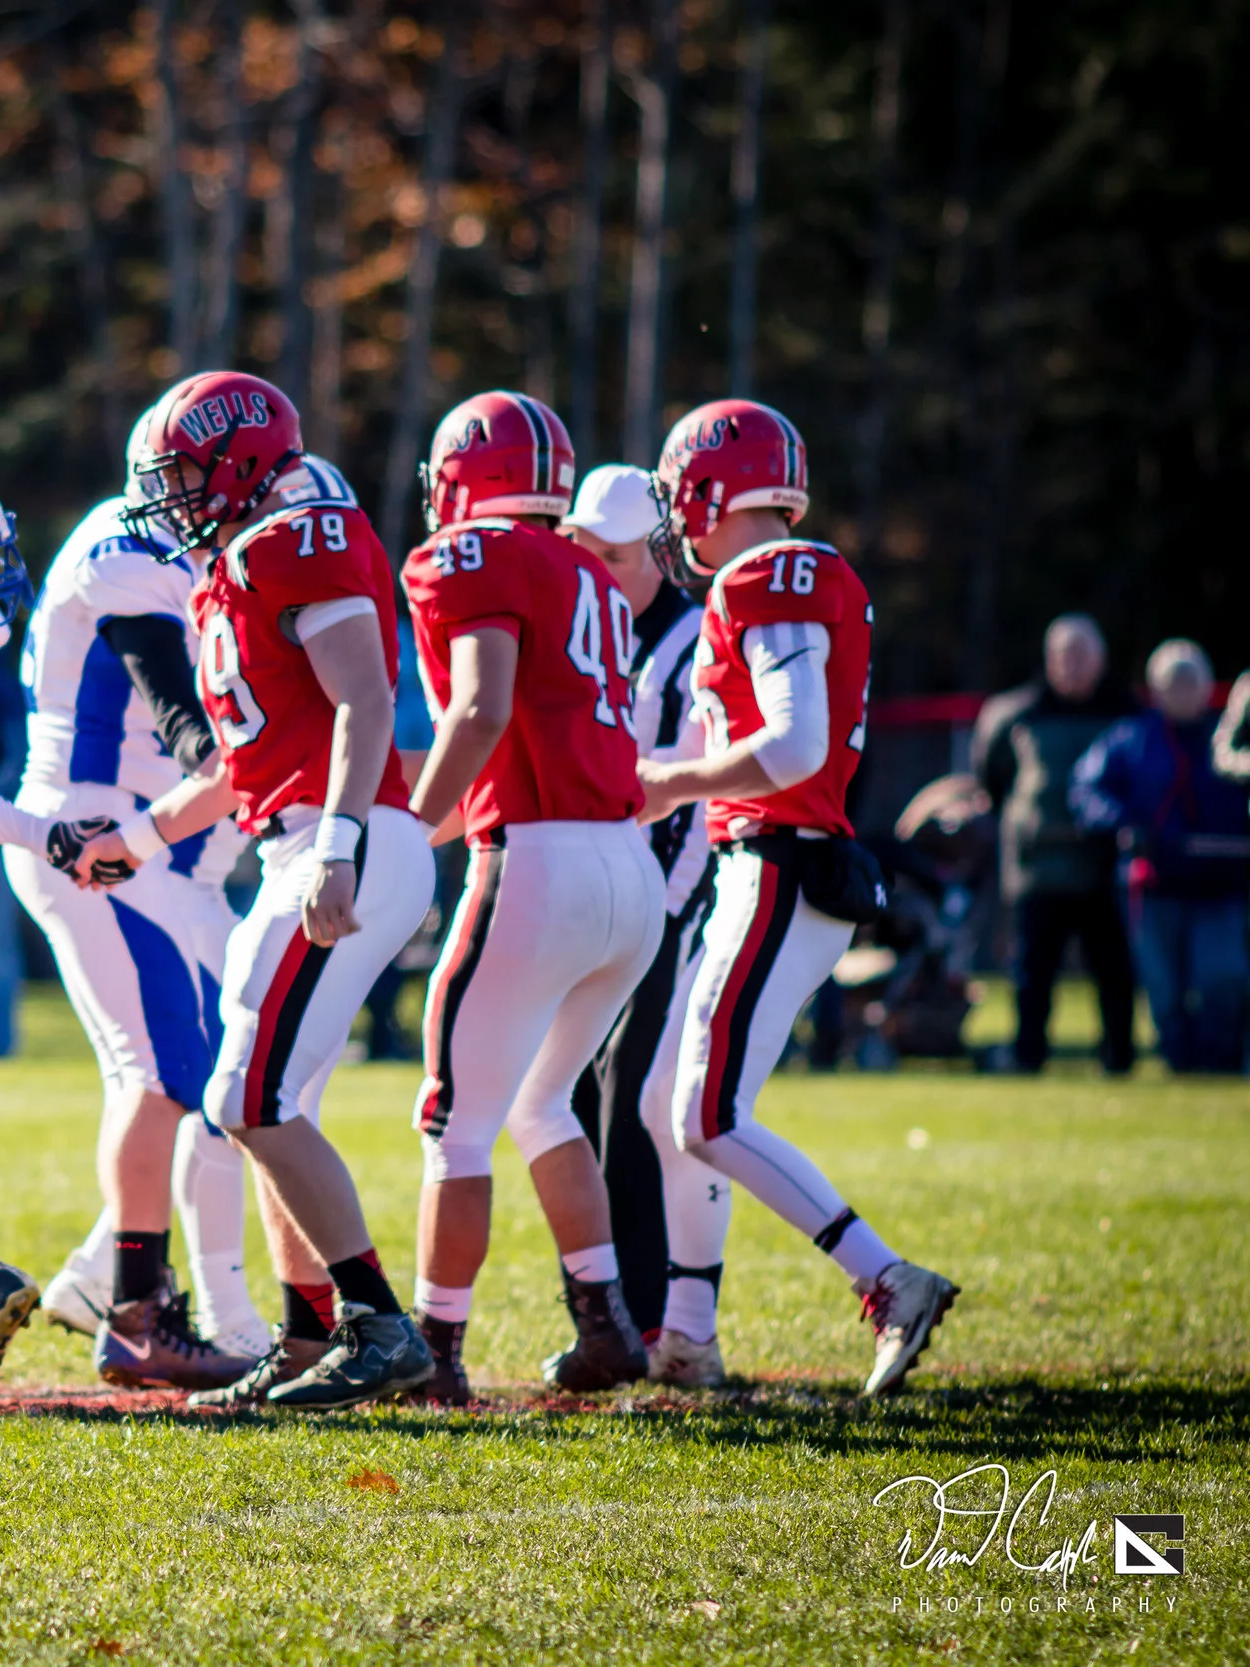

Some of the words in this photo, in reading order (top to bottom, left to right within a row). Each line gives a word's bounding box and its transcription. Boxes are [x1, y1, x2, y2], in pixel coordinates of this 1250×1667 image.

[178, 391, 270, 447] WELLS
[664, 417, 729, 469] LLS
[289, 512, 349, 558] 79
[430, 531, 484, 577] 49
[768, 552, 818, 595] 16
[565, 564, 638, 743] 49
